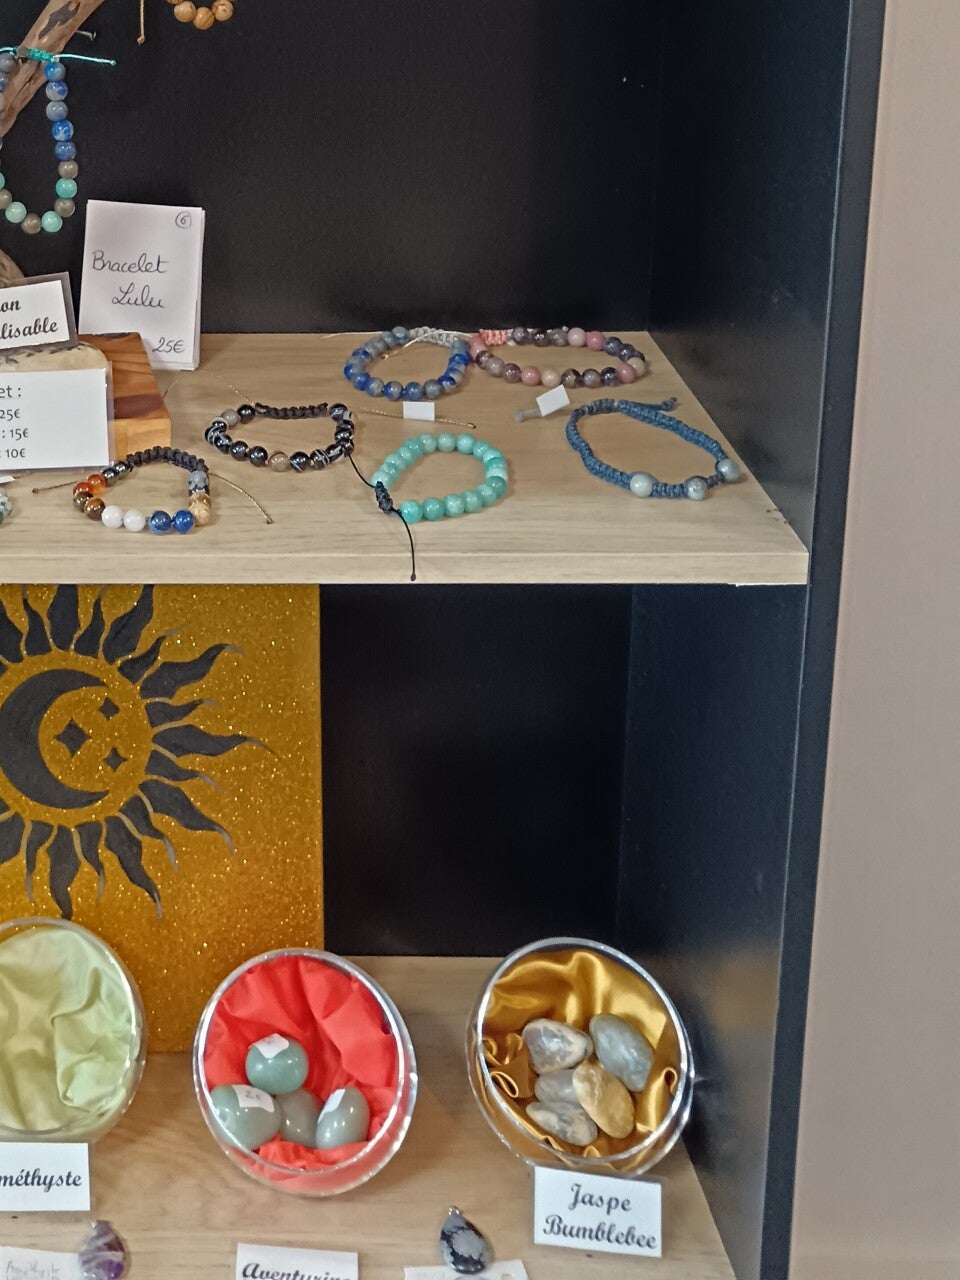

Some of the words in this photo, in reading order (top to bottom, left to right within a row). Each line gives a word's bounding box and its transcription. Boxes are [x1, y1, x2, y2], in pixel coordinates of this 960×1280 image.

[91, 249, 169, 274] Bracelet
[111, 282, 166, 308] Lulu
[151, 336, 186, 354] 25€
[0, 408, 21, 421] 25€
[9, 428, 29, 441] 15€
[5, 447, 26, 459] 10€
[568, 1182, 632, 1216] Jaspe
[542, 1214, 657, 1249] Bumblebee
[241, 1262, 352, 1280] Aventuri
